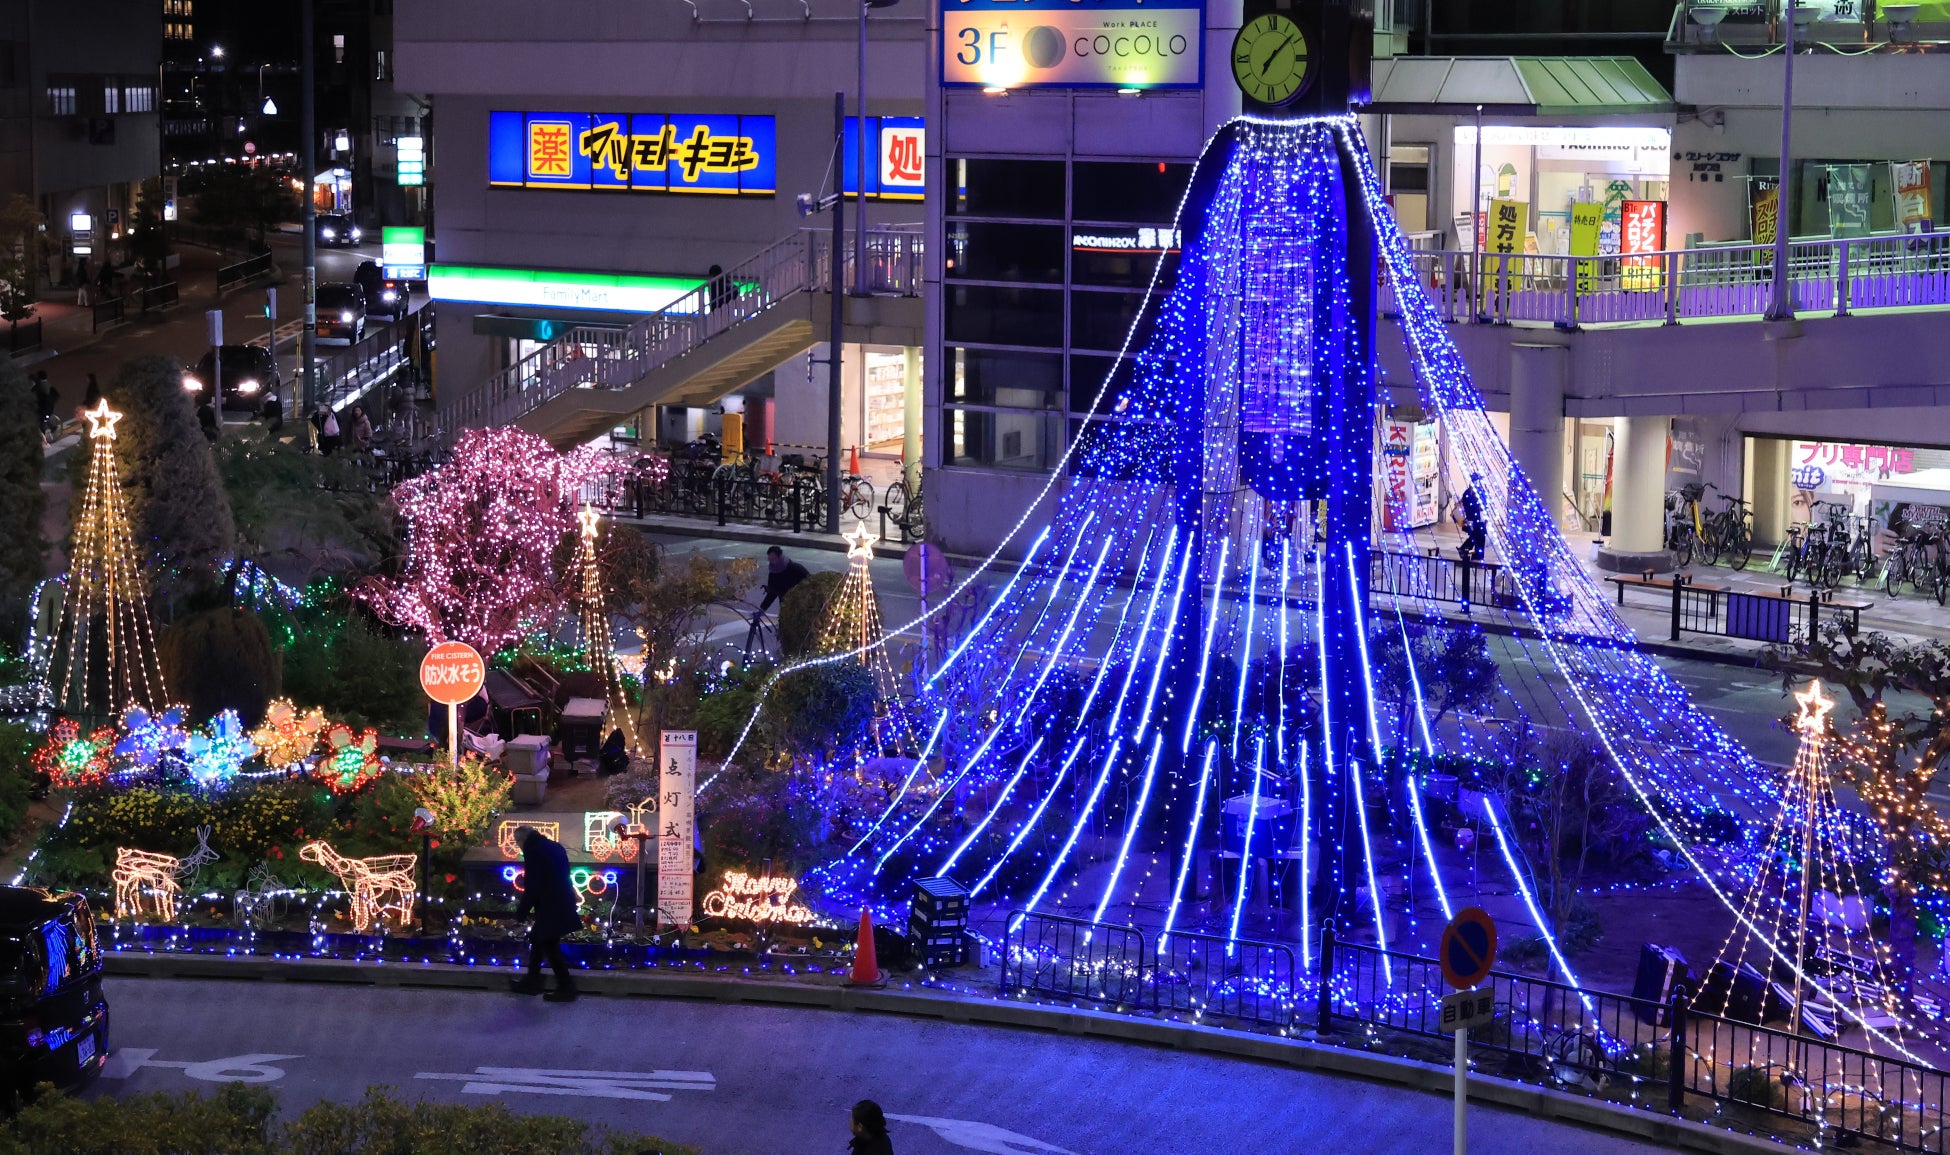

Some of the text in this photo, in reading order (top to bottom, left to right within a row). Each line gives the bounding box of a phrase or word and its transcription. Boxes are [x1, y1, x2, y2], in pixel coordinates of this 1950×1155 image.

[957, 27, 1008, 65] 3F
[1074, 34, 1187, 57] COCOLO
[533, 127, 567, 172] 薬
[582, 124, 757, 178] マツモトキヨシ
[888, 134, 922, 180] 処
[543, 286, 609, 304] FamilyMart
[1800, 442, 1914, 473] プリ専門店
[431, 652, 474, 660] FIRE CISTERN
[424, 663, 481, 685] 防火水そう
[663, 758, 682, 839] 点灯式
[1443, 996, 1492, 1024] 自動車
